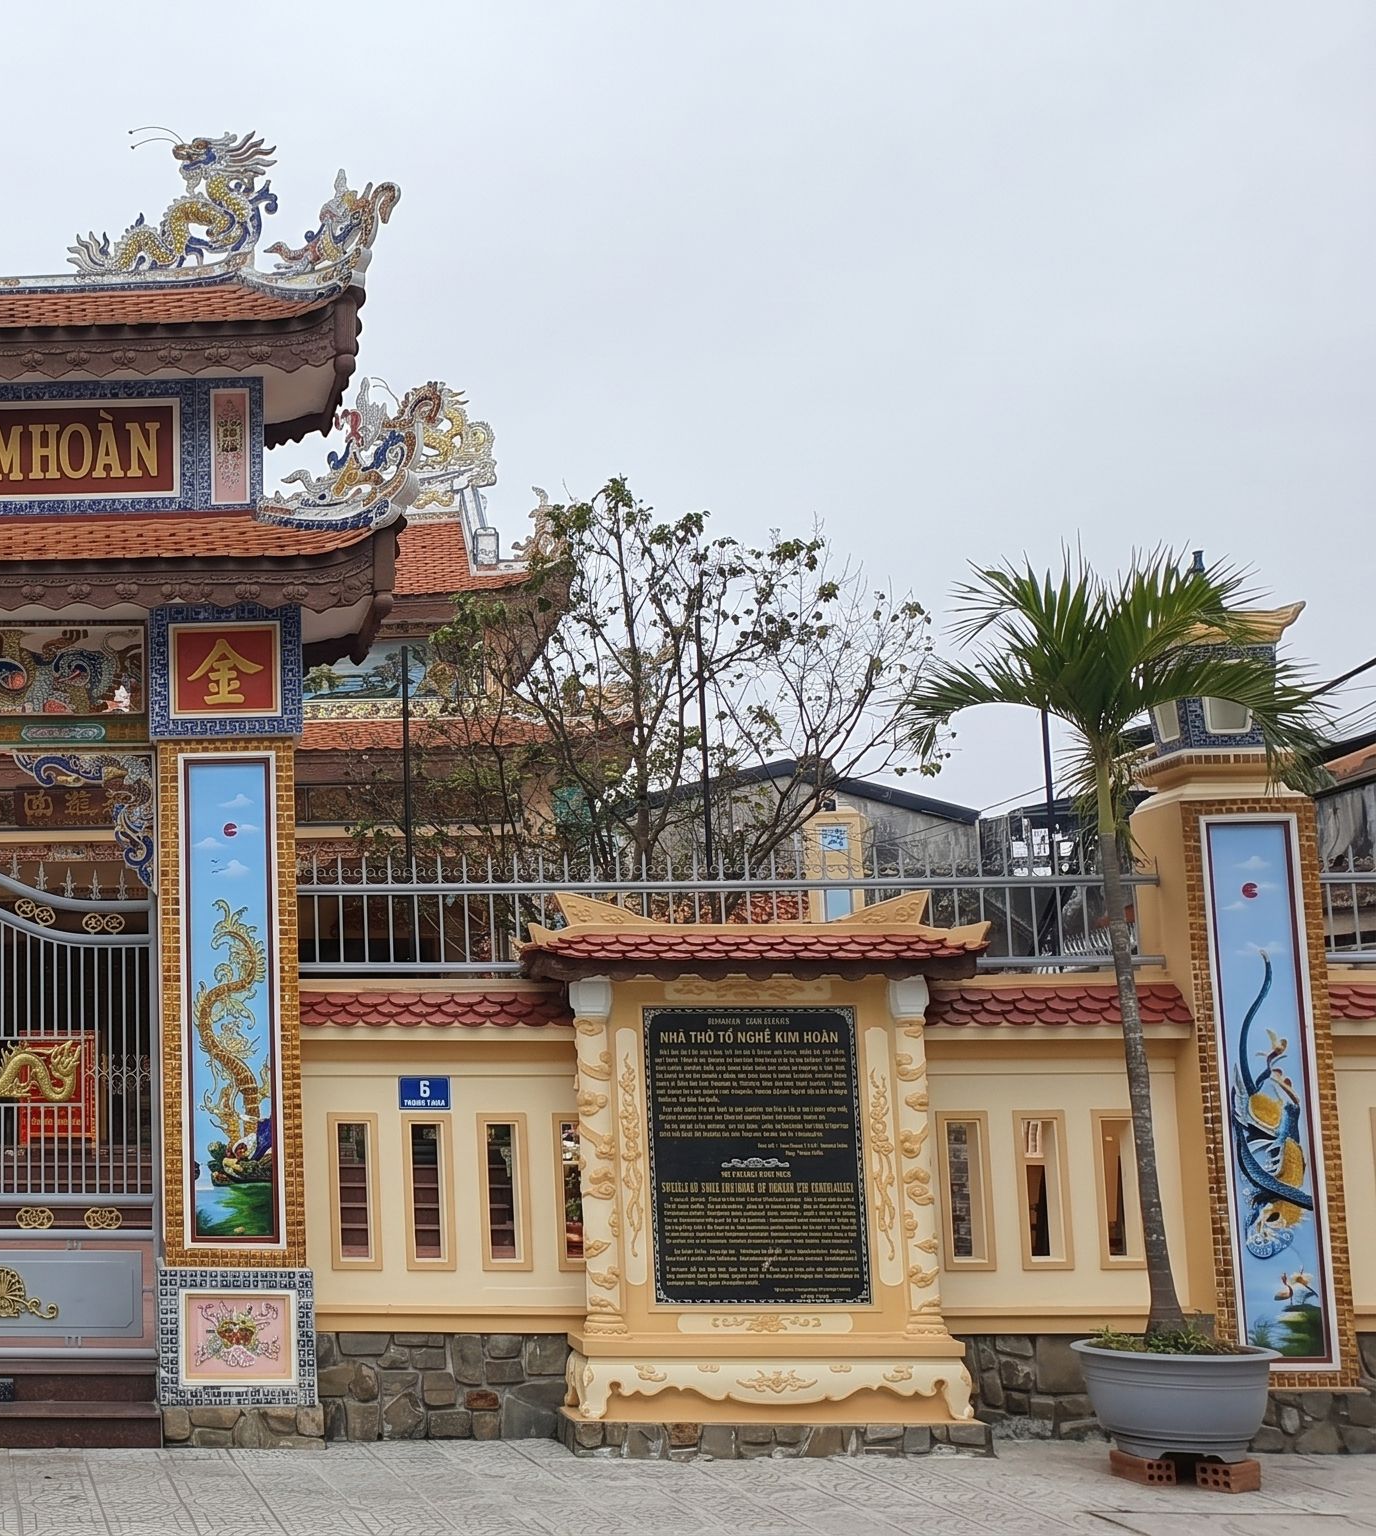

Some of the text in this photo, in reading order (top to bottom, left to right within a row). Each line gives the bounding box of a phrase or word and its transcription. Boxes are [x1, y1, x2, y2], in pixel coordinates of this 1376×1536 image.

[28, 410, 160, 480] HOÀN
[187, 639, 264, 705] 金
[690, 1028, 714, 1044] THỜ
[775, 1031, 799, 1044] KIM
[804, 1028, 839, 1044] HOÀN
